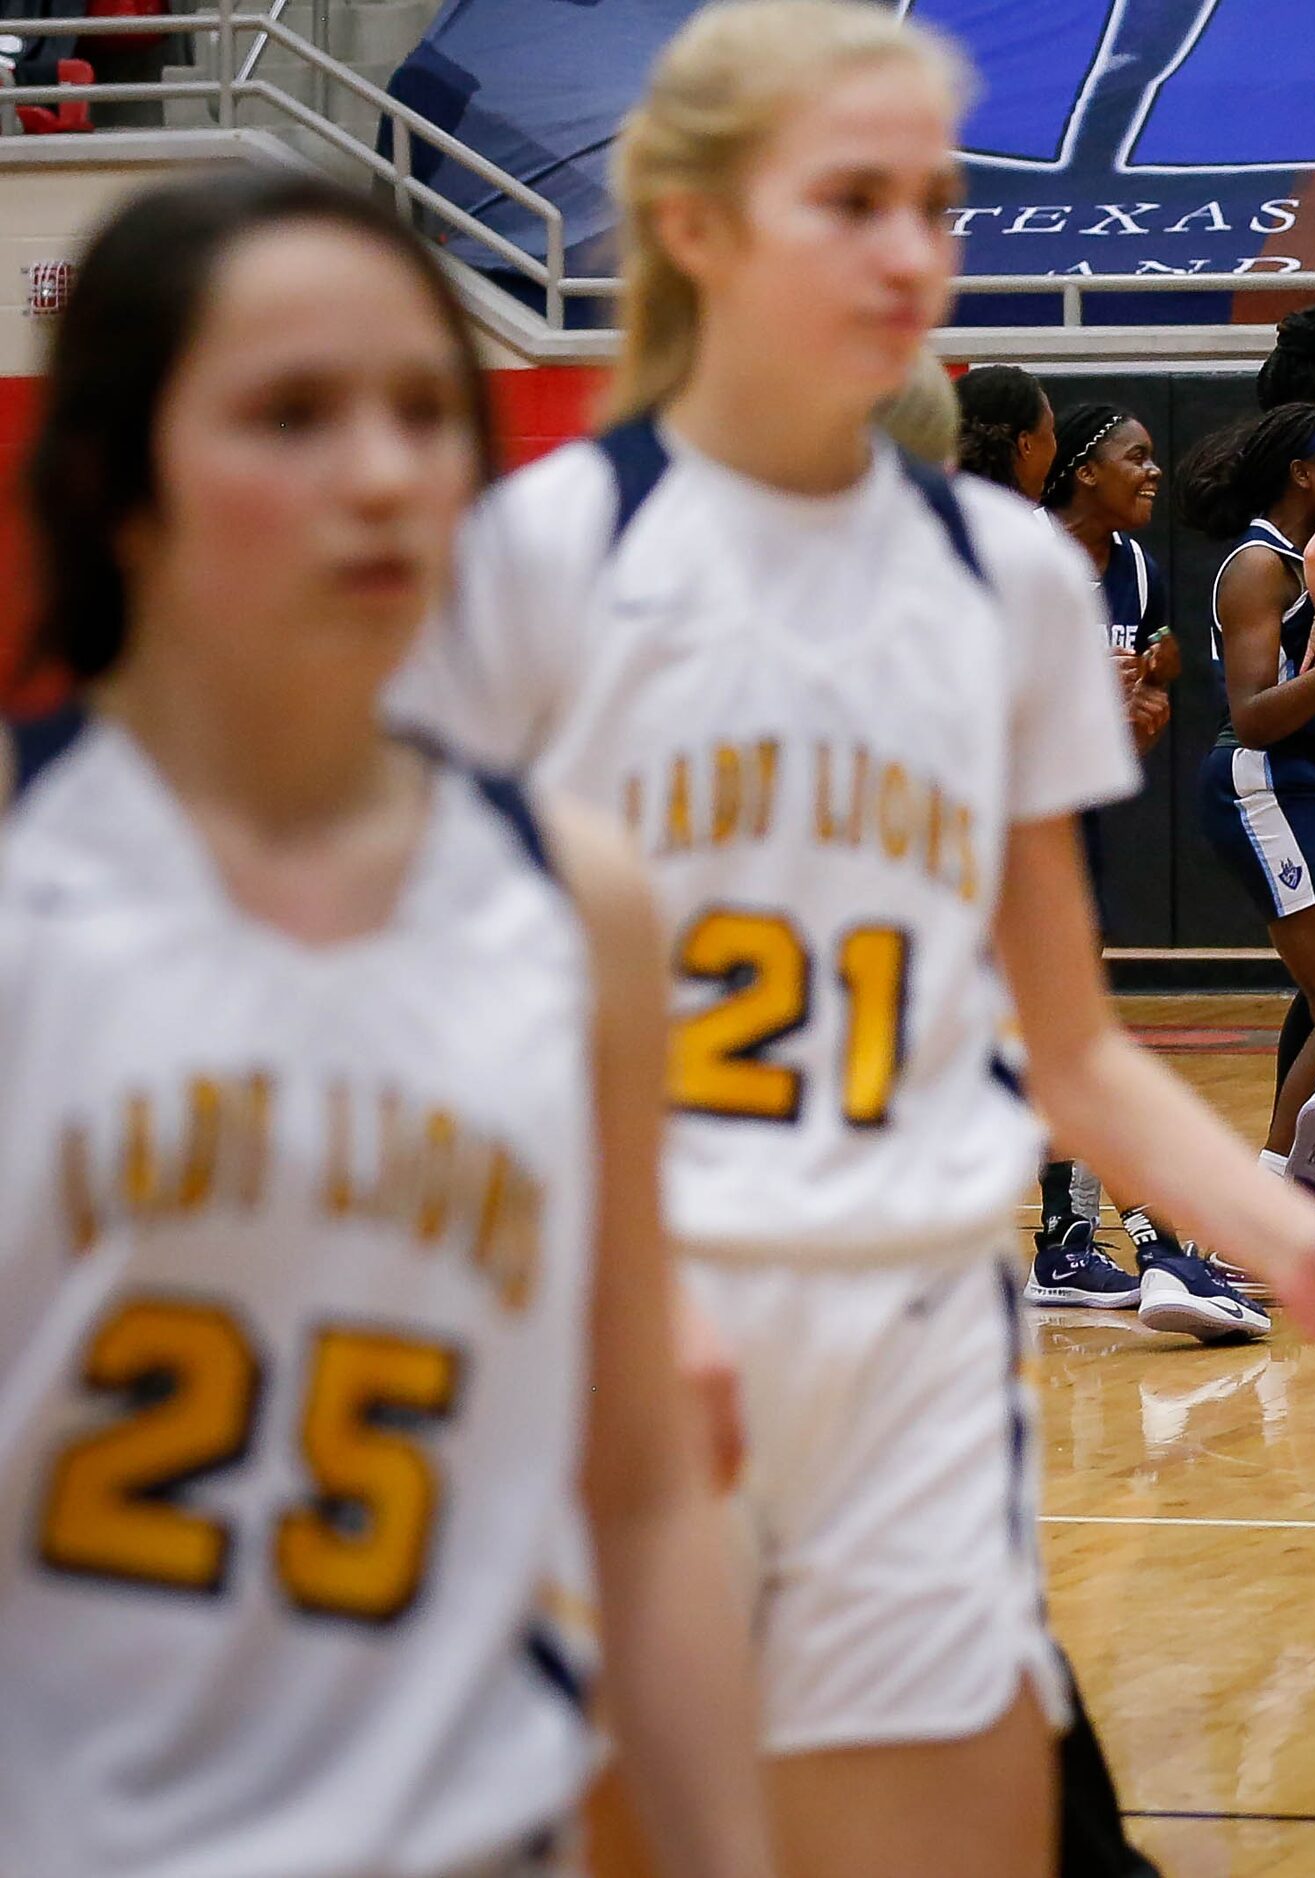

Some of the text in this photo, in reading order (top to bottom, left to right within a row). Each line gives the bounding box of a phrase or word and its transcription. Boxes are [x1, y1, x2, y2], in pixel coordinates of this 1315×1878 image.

[943, 198, 1300, 237] TEXAS
[666, 907, 912, 1128] 21
[36, 1296, 468, 1636] 25
